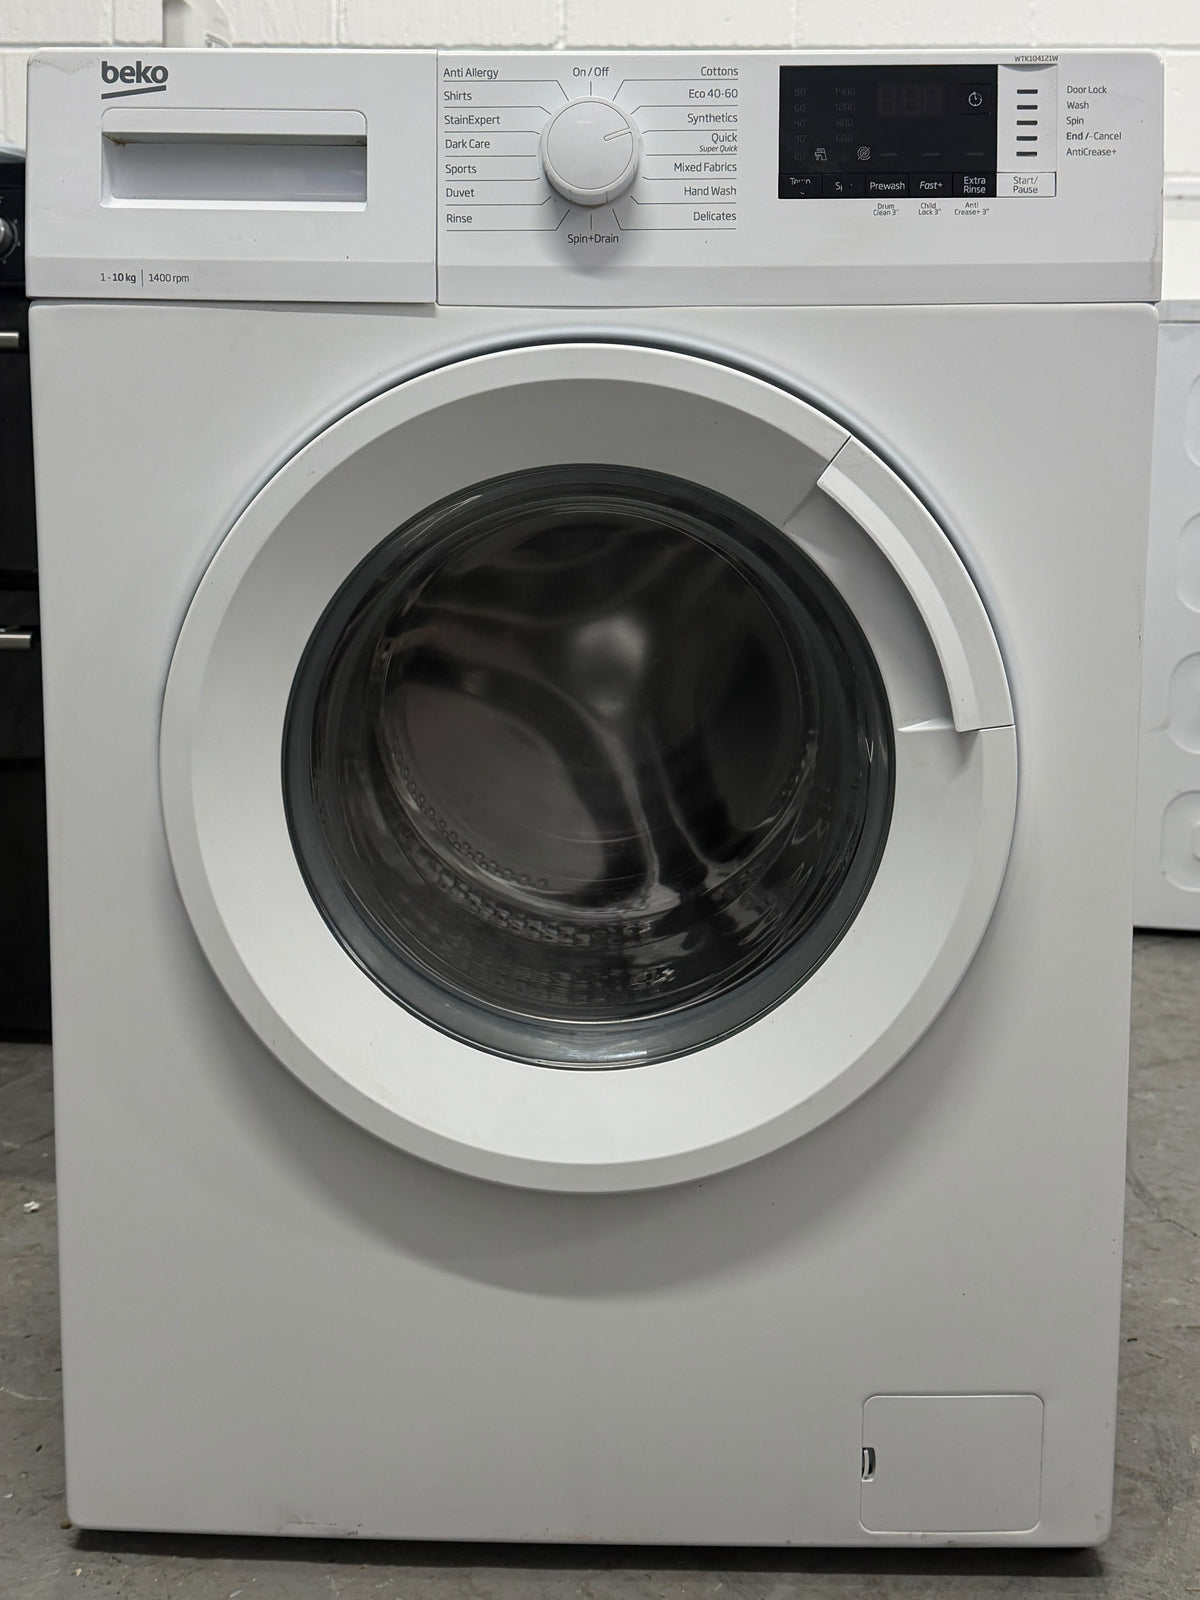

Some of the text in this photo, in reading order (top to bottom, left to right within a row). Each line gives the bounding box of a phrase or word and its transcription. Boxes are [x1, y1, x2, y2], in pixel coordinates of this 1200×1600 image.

[101, 60, 169, 84] beko
[443, 68, 499, 79] Anti Allergy
[572, 67, 587, 77] On
[594, 67, 610, 77] Off
[700, 66, 739, 76] Cottons
[688, 88, 739, 99] Eco 40-60
[1066, 85, 1108, 94] Door Lock
[443, 91, 473, 101] Shirts
[1066, 101, 1090, 110] Wash
[444, 114, 501, 126] StainExpert
[687, 113, 738, 125] Synthetics
[1066, 116, 1085, 126] Spin
[711, 132, 738, 144] Quick
[1066, 132, 1084, 141] End
[445, 139, 491, 149] Dark Care
[1066, 147, 1117, 157] AntiCrease+
[445, 164, 477, 176] Sports
[674, 162, 737, 172] Mixed Fabrics
[919, 181, 943, 190] Fast+
[963, 176, 986, 185] Extra
[1013, 176, 1038, 185] Start/
[684, 186, 737, 196] Hand Wash
[869, 181, 906, 191] Prewash
[963, 185, 986, 194] Rinse
[1013, 186, 1038, 194] Pause
[445, 188, 475, 198] Duvet
[693, 211, 737, 222] Delicates
[954, 208, 980, 216] Crease+
[446, 213, 473, 224] Rinse
[567, 234, 619, 245] Spin+Drain
[125, 273, 137, 284] kg
[149, 273, 190, 284] 1400 rpm
